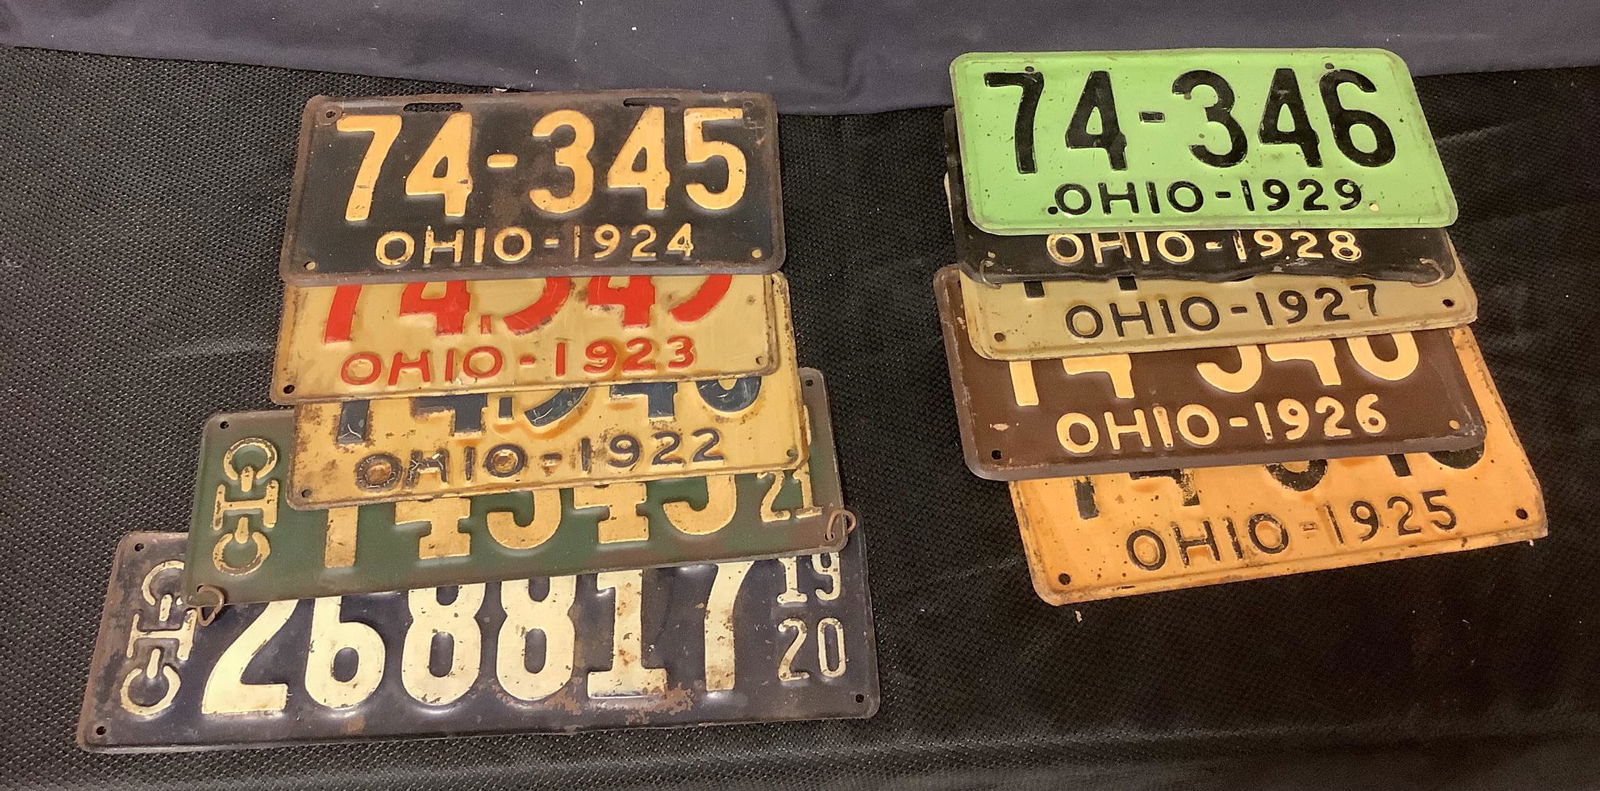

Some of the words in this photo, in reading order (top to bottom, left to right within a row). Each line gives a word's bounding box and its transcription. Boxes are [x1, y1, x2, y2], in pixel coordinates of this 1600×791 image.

[983, 67, 1396, 174] 74-346
[336, 106, 748, 222] 74-345
[1053, 178, 1362, 215] OHIO-1929
[375, 223, 694, 266] OHIO-1924
[1046, 230, 1362, 266] OHIO-1928
[1065, 283, 1379, 340] OHIO-1927
[340, 336, 696, 387] OHIO-1923
[1056, 394, 1387, 454] OHIO-1926
[354, 428, 724, 491] OHIO-1922
[756, 462, 823, 523] 21
[1125, 489, 1458, 572] OHIO-1925
[776, 552, 841, 605] 19
[201, 560, 756, 715] 268817
[777, 617, 848, 682] 20
